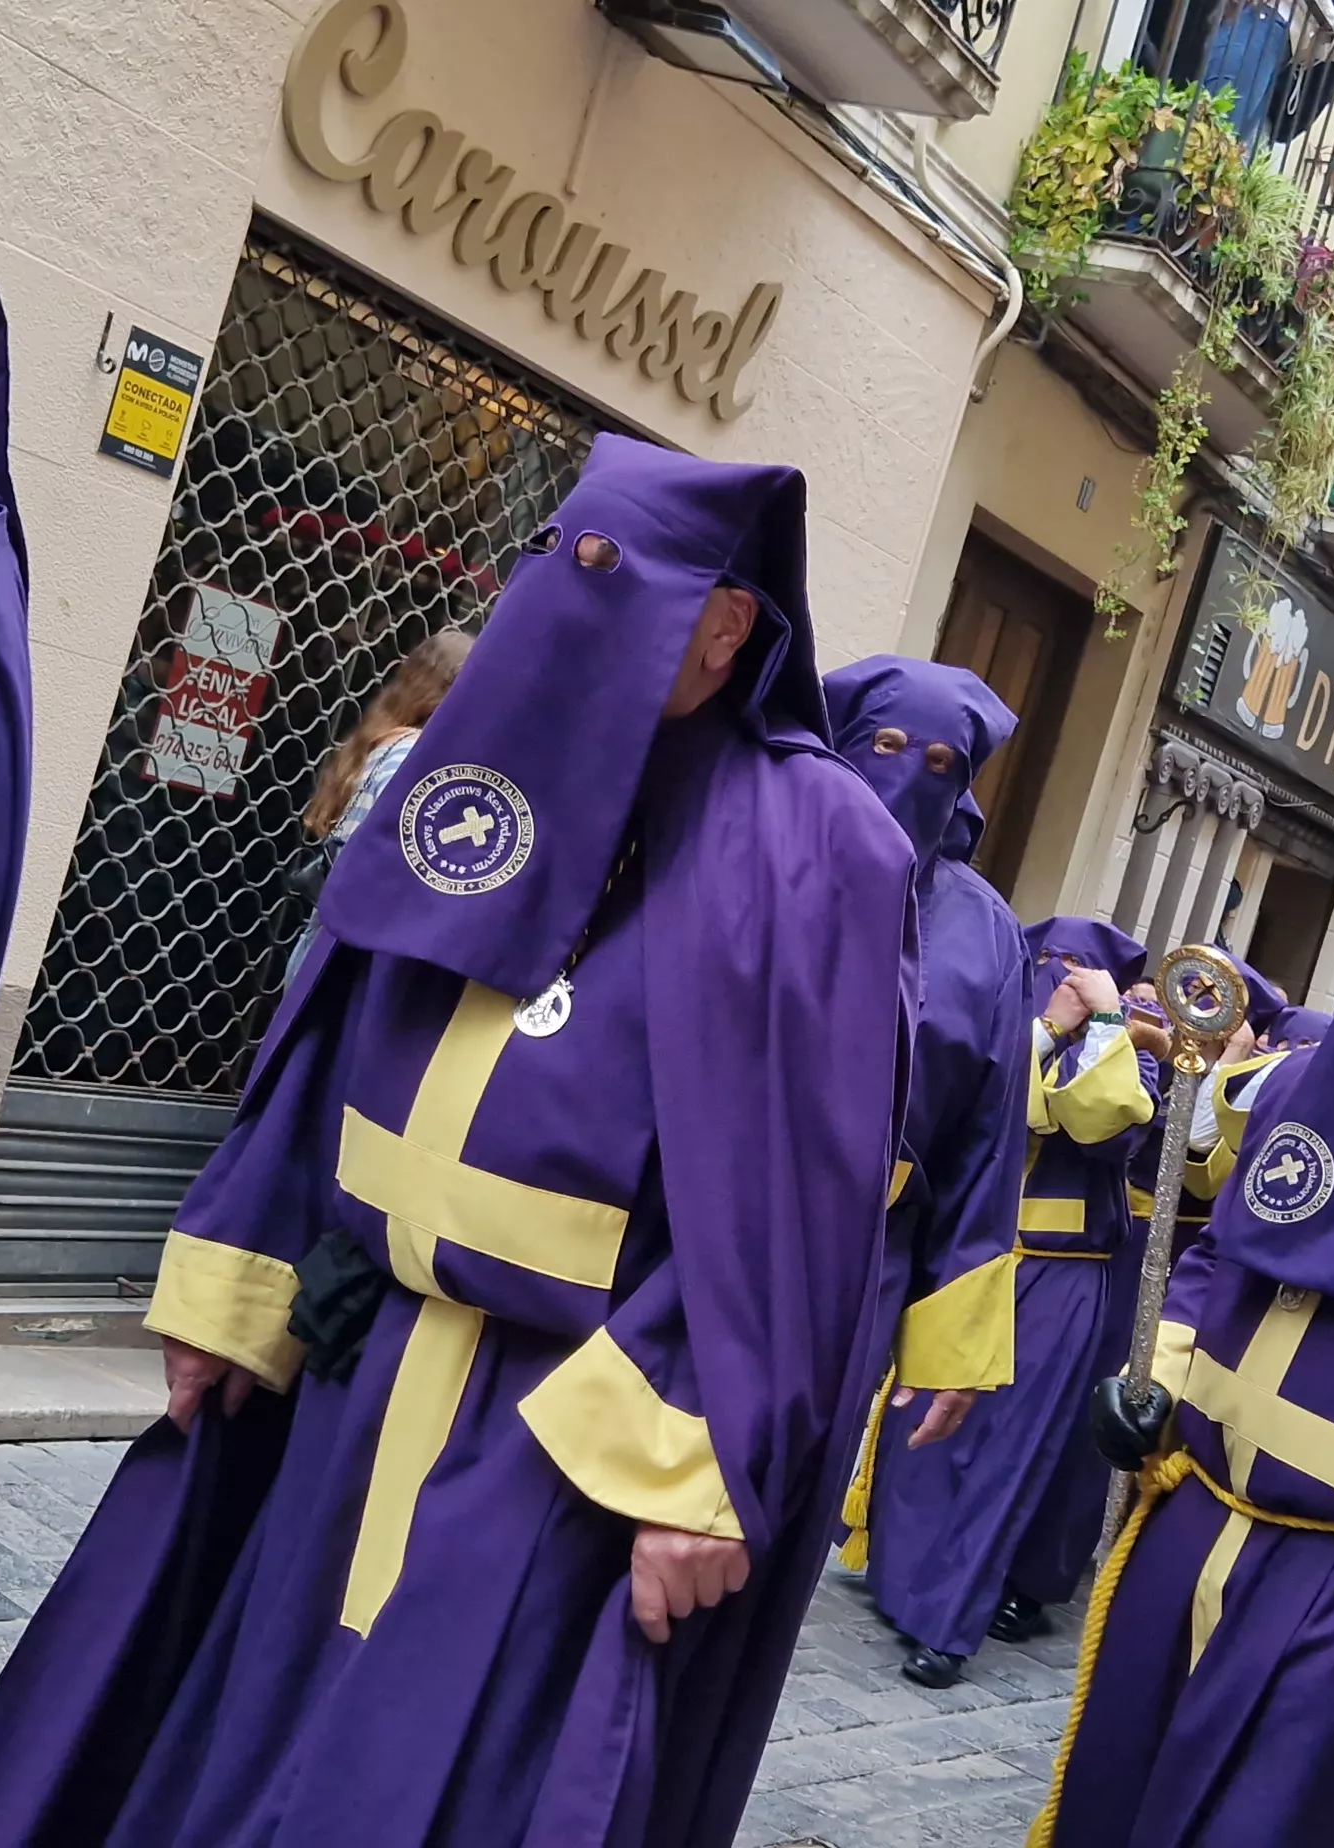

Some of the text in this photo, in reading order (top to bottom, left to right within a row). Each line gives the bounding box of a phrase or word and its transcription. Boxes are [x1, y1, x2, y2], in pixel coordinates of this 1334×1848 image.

[282, 0, 783, 421] Caroussel
[124, 381, 182, 414] CONECTADA
[178, 693, 239, 730] LOCAL
[434, 770, 449, 785] DE
[451, 767, 501, 786] NUESTRO
[484, 789, 505, 815] Rex
[500, 782, 526, 814] PADRE
[520, 814, 534, 846] JESUS
[403, 835, 422, 868] REAL
[424, 869, 466, 893] HUESCA
